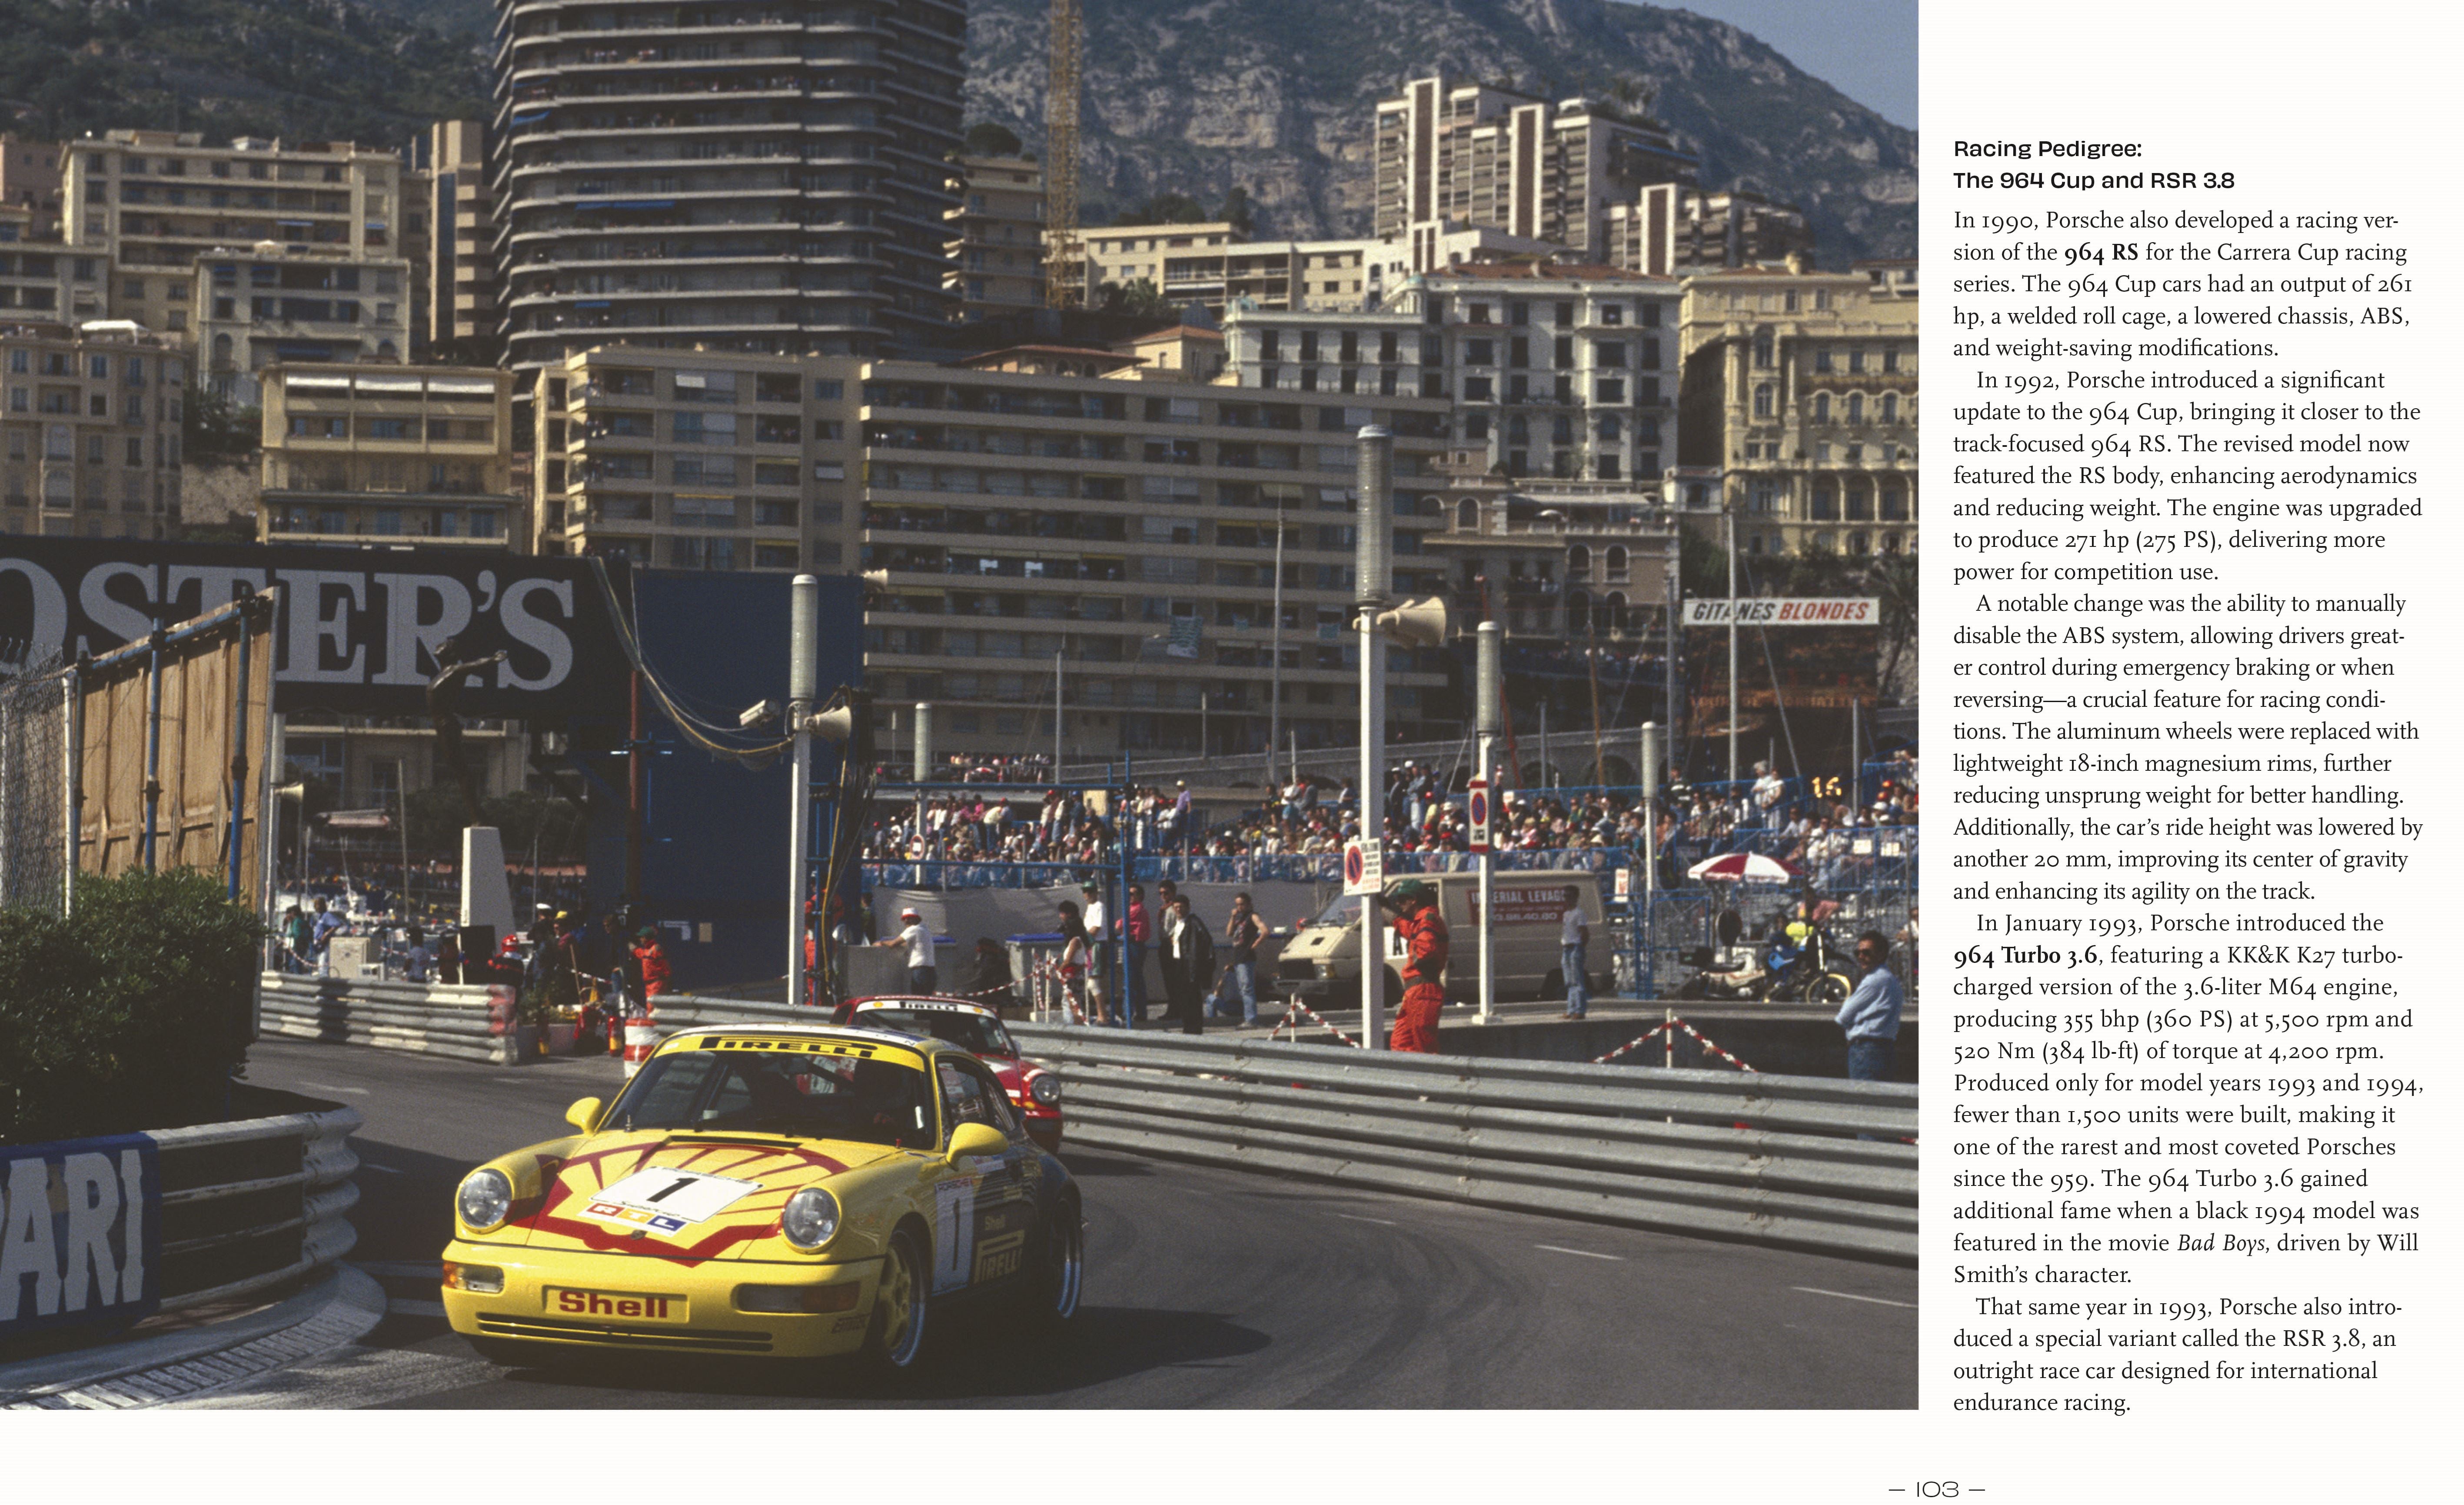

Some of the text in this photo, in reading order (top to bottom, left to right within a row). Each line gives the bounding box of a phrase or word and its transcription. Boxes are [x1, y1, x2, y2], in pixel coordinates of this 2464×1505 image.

[1955, 140, 2141, 160] Racing Pedigree:
[1953, 172, 2235, 191] The 964 Cup and RSR 3.8
[1955, 210, 2398, 234] In 1990, Porsche also developed a racing ver-
[1954, 273, 2412, 298] series. The 964 Cup cars had an output of 261
[1953, 306, 2409, 330] hp, a welded roll cage, a lowered chassis, ABS,
[1977, 370, 2385, 394] In 1992, Porsche introduced a significant
[1953, 433, 2410, 458] track-focused 964 RS. The revised model now
[1953, 465, 2417, 489] featured the RS body, enhancing aerodynamics
[1953, 529, 2385, 553] to produce 271 hp (275 PS), delivering more
[1778, 602, 1869, 620] BLONDES
[1975, 593, 2406, 617] A notable change was the ability to manually
[1954, 657, 2394, 681] er control during emergency braking or when
[1953, 721, 2420, 745] tions. The aluminum wheels were replaced with
[1953, 753, 2392, 777] lightweight 18-inch magnesium rims, further
[1953, 849, 2408, 873] another 20 mm, improving its center of gravity
[1471, 891, 1524, 904] IERIAL
[1977, 912, 2384, 937] In January 1993, Porsche introduced the
[1954, 945, 2403, 969] 964 Turbo 3.6, featuring a KK&K K27 turbo-
[699, 1036, 878, 1059] PIRELLI
[1955, 1072, 2423, 1097] Produced only for model years 1993 and 1994,
[646, 1177, 700, 1203] 1
[589, 1204, 682, 1231] RTL
[1953, 1200, 2419, 1225] additional fame when a black 1994 model was
[0, 1149, 145, 1321] ARI
[952, 1198, 961, 1271] 1
[559, 1290, 668, 1318] Shell
[1975, 1296, 2402, 1321] That same year in 1993, Porsche also intro-
[1917, 1481, 1959, 1498] 103
